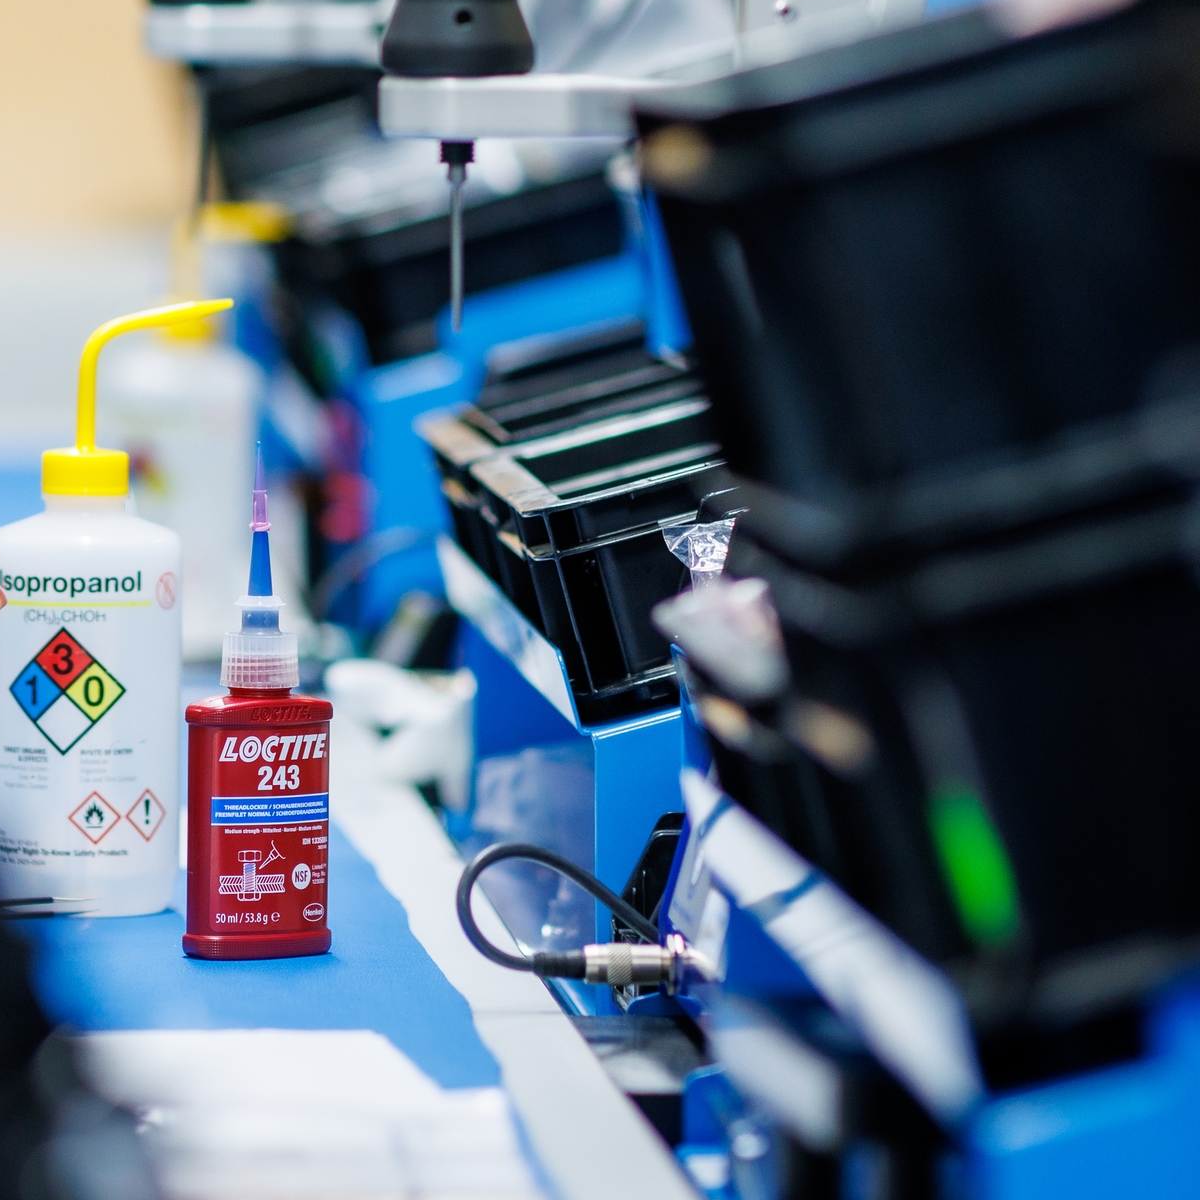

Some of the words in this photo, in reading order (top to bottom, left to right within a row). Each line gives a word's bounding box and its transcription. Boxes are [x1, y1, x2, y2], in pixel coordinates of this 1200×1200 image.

[0, 569, 141, 598] Isopropanol
[52, 643, 73, 675] 3
[26, 675, 37, 705] 1
[84, 676, 104, 707] 0
[257, 765, 300, 791] 243
[294, 870, 308, 883] NSF
[215, 913, 226, 923] 50
[227, 912, 238, 923] ml
[245, 912, 262, 923] 53.8
[262, 914, 268, 925] g
